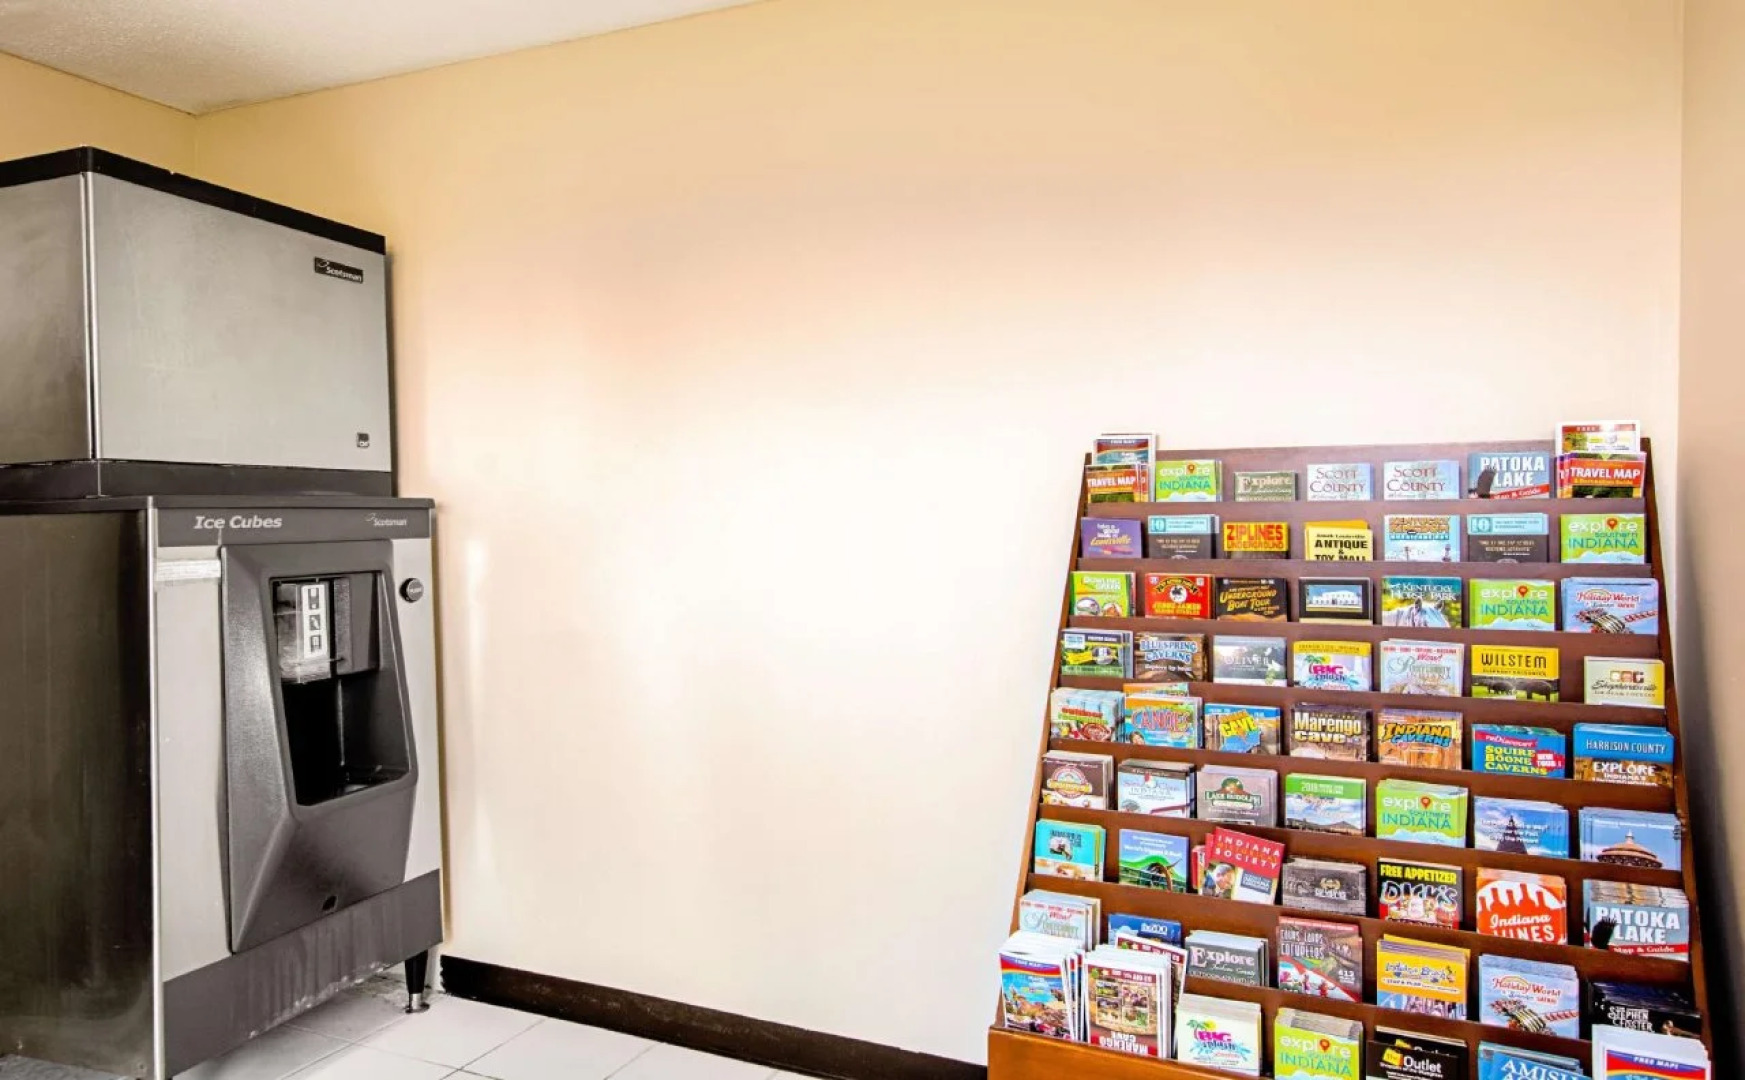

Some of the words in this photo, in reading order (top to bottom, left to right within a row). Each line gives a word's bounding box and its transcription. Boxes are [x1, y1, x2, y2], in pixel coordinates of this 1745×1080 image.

[1480, 456, 1545, 472] PATOKA
[1495, 471, 1534, 488] LAKE
[1570, 467, 1611, 478] TRAVEL
[1613, 468, 1641, 479] MAP
[1088, 477, 1117, 488] TRAVEL
[1117, 477, 1136, 486] MAP
[1159, 480, 1212, 490] INDIANA
[1237, 475, 1292, 492] Explore
[1309, 481, 1366, 493] COUNTY
[1386, 479, 1446, 492] COUNTY
[194, 515, 225, 529] Ice
[229, 515, 283, 529] Cubes
[1568, 521, 1638, 533] explore
[1226, 525, 1284, 541] ZIPLINES
[1314, 539, 1368, 550] ANTIQUE
[1568, 538, 1638, 549] INDIANA
[1402, 583, 1452, 593] KENTUCKY
[1480, 587, 1548, 600] explore
[1219, 588, 1277, 604] UNDERGROUND
[1430, 591, 1457, 601] PARK
[1577, 592, 1612, 602] Holiday
[1614, 592, 1640, 601] World
[1226, 600, 1249, 612] BOAT
[1250, 598, 1271, 610] TOUR
[1480, 604, 1549, 616] INDIANA
[1140, 641, 1198, 653] BLUESPRING
[1145, 651, 1192, 664] CAVERNS
[1481, 653, 1547, 669] WILSTEM
[1312, 664, 1344, 675] BIG
[1219, 715, 1257, 738] CAVE
[1294, 711, 1362, 736] Marengo
[1294, 730, 1347, 743] cave
[1382, 722, 1452, 742] INDIANA
[1390, 734, 1453, 748] CAVERNS
[1586, 738, 1630, 751] HARRISON
[1631, 742, 1666, 754] COUNTY
[1485, 745, 1536, 758] SQUIRE
[1485, 753, 1533, 766] BOONE
[1485, 761, 1548, 776] CAVERNS
[1593, 760, 1657, 776] EXPLORE
[1382, 795, 1451, 812] explore
[1381, 812, 1452, 831] INDIANA
[1218, 834, 1281, 857] INDIANA
[1215, 847, 1278, 870] SOCIETY
[1380, 863, 1403, 877] FREE
[1404, 864, 1457, 885] APPETIZER
[1490, 914, 1552, 929] Indiana
[1595, 906, 1681, 930] PATOKA
[1613, 925, 1667, 944] LAKE
[1189, 946, 1255, 967] Explore
[1613, 947, 1634, 955] Map
[1646, 946, 1675, 954] Guide
[1492, 977, 1530, 994] Holiday
[1531, 984, 1561, 997] World
[1198, 1031, 1232, 1042] BIG
[1280, 1037, 1352, 1057] explore
[1279, 1051, 1353, 1076] INDIANA
[1403, 1054, 1443, 1073] Outlet
